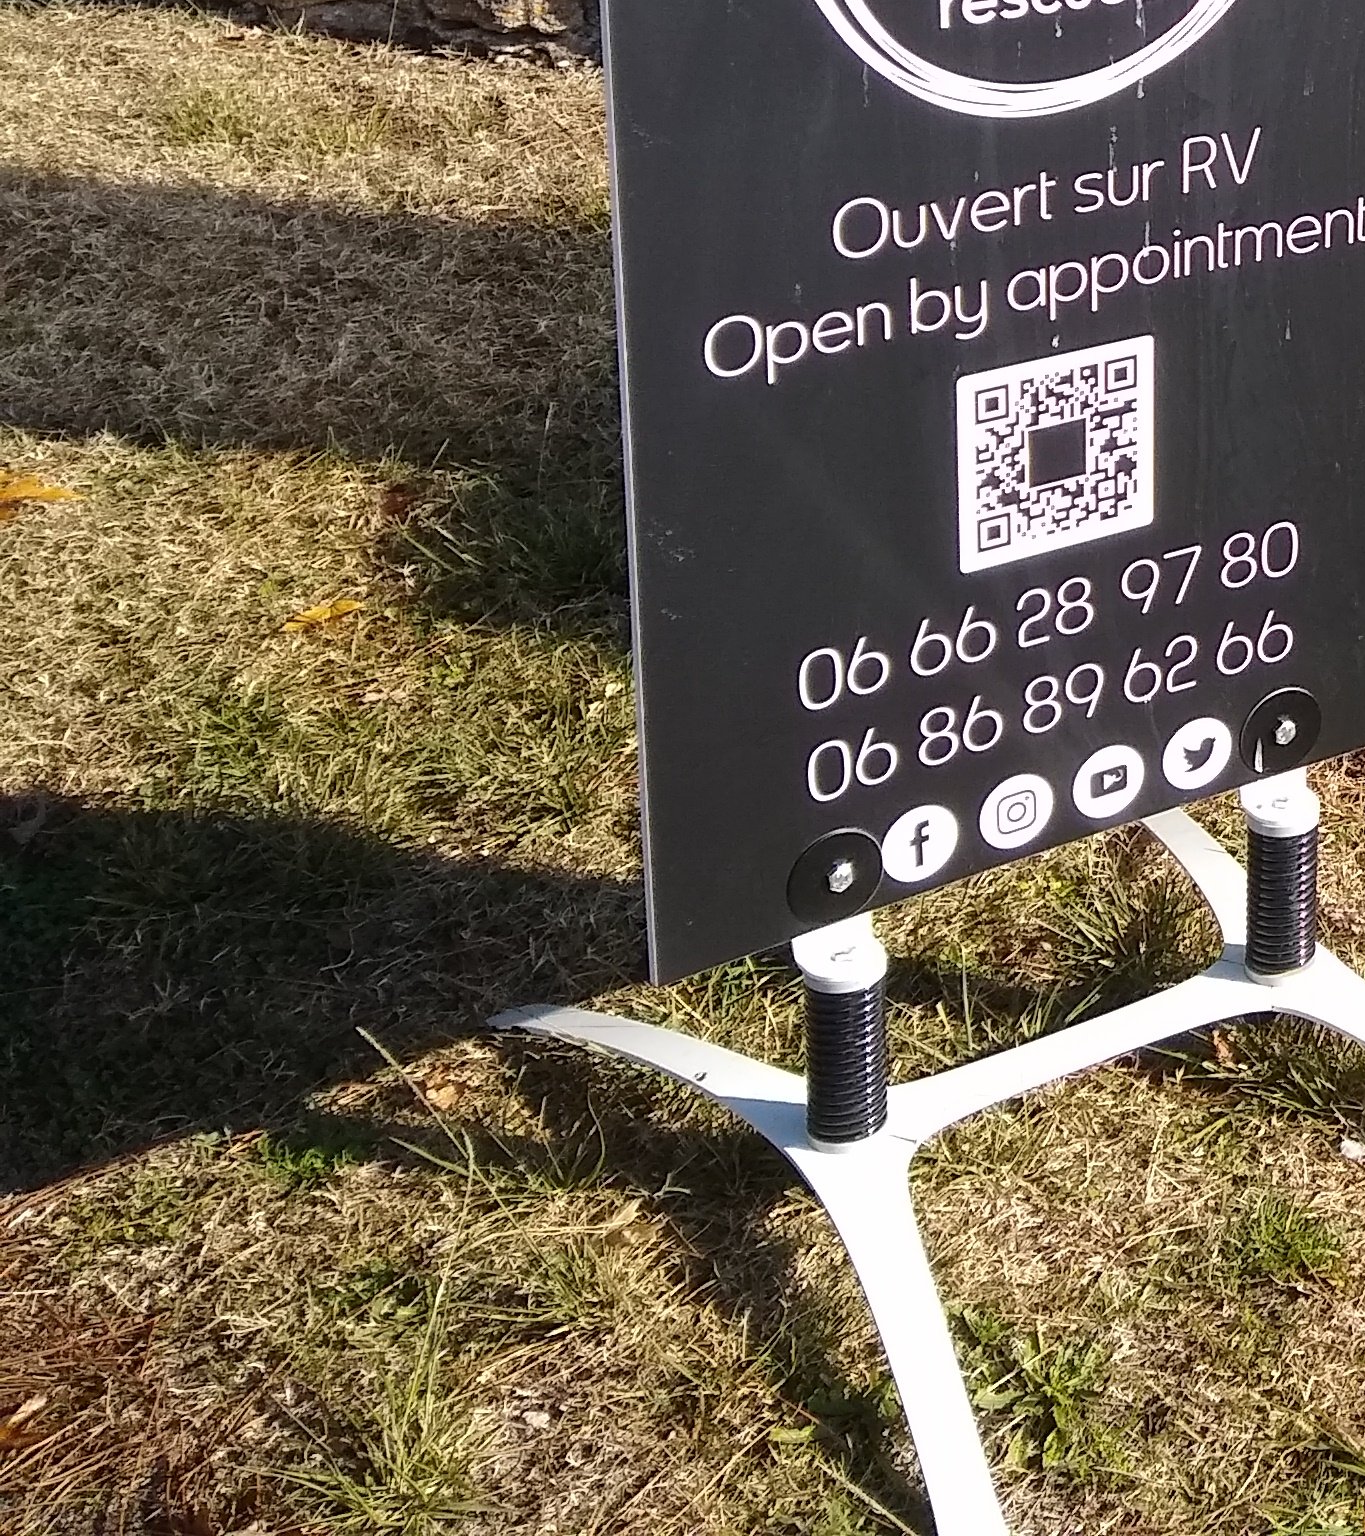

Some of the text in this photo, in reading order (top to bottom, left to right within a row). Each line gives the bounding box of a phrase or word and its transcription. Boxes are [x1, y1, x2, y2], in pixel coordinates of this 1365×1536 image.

[833, 128, 1260, 258] Ouvert sur RV
[705, 303, 891, 384] Open
[910, 278, 988, 339] by
[799, 522, 1298, 710] 06 66 28 97 80
[808, 610, 1293, 801] 06 86 89 62 66
